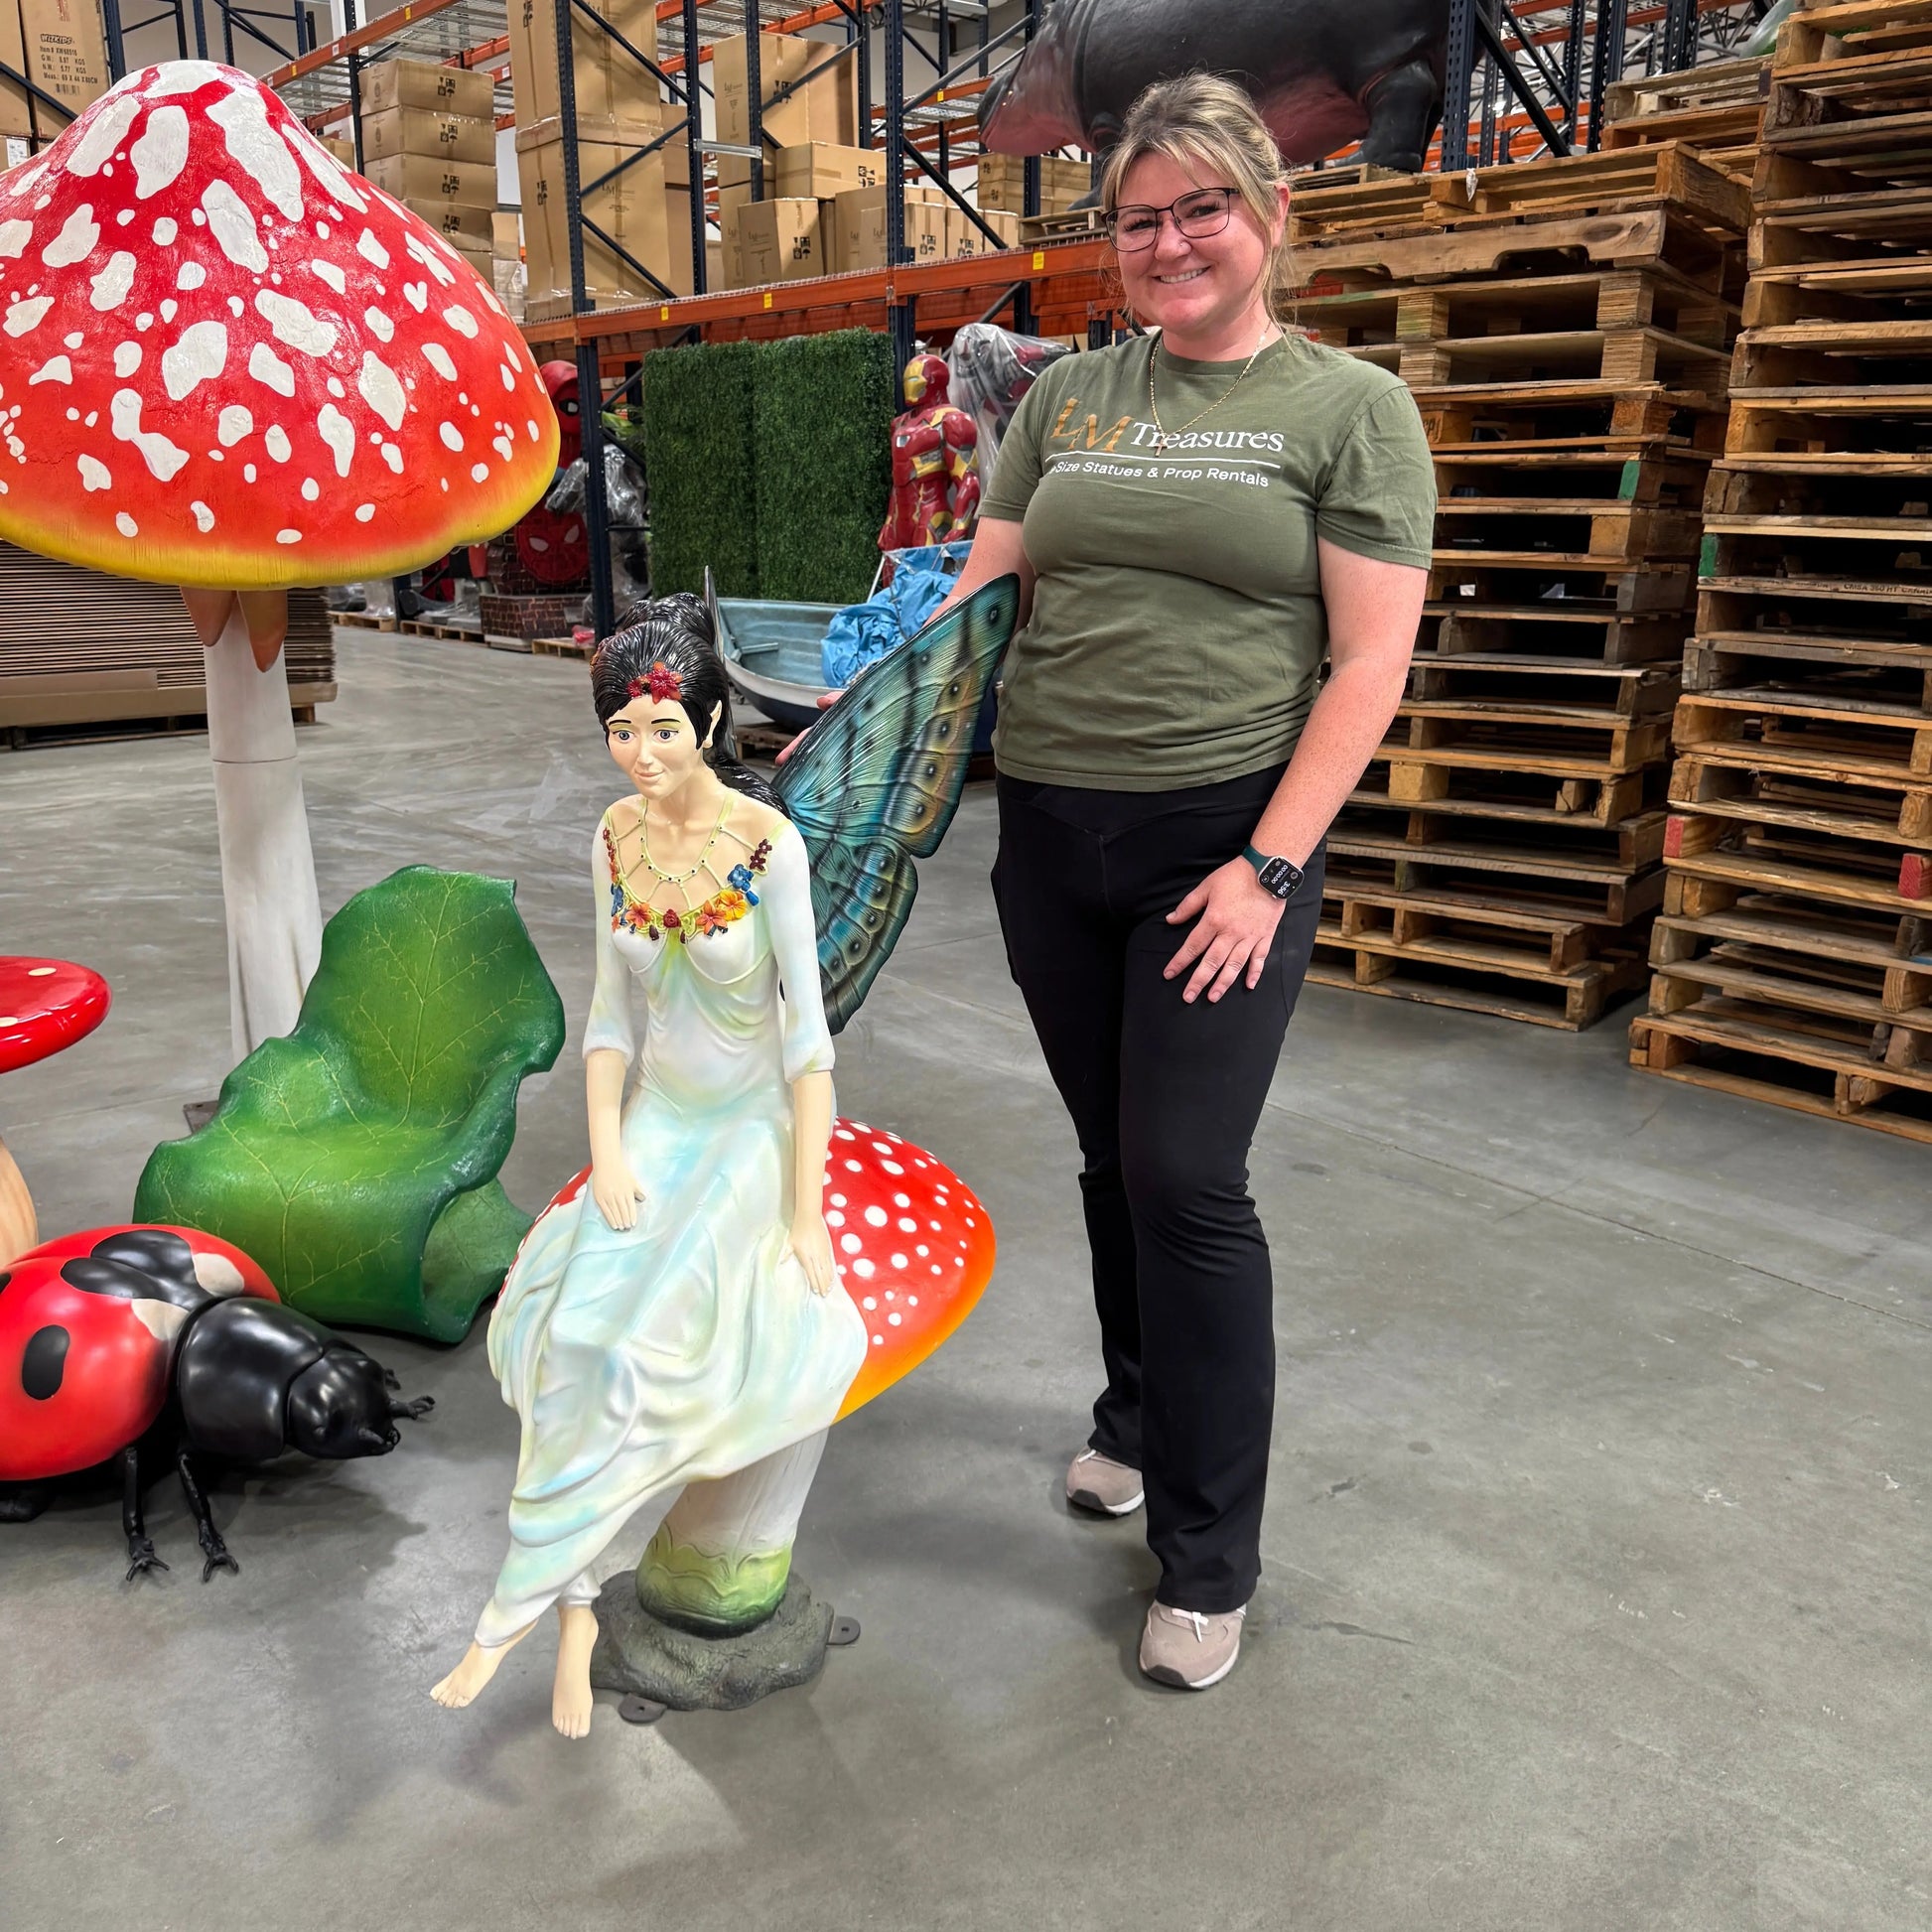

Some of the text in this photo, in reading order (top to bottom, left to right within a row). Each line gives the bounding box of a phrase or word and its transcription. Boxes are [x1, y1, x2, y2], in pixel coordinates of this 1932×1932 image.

[41, 34, 72, 45] WIZKIDS
[1049, 397, 1285, 453] LM Treasures
[1082, 462, 1144, 478] Statues
[1147, 467, 1160, 479] &
[1163, 467, 1203, 481] Prop
[1206, 467, 1270, 487] Rentals
